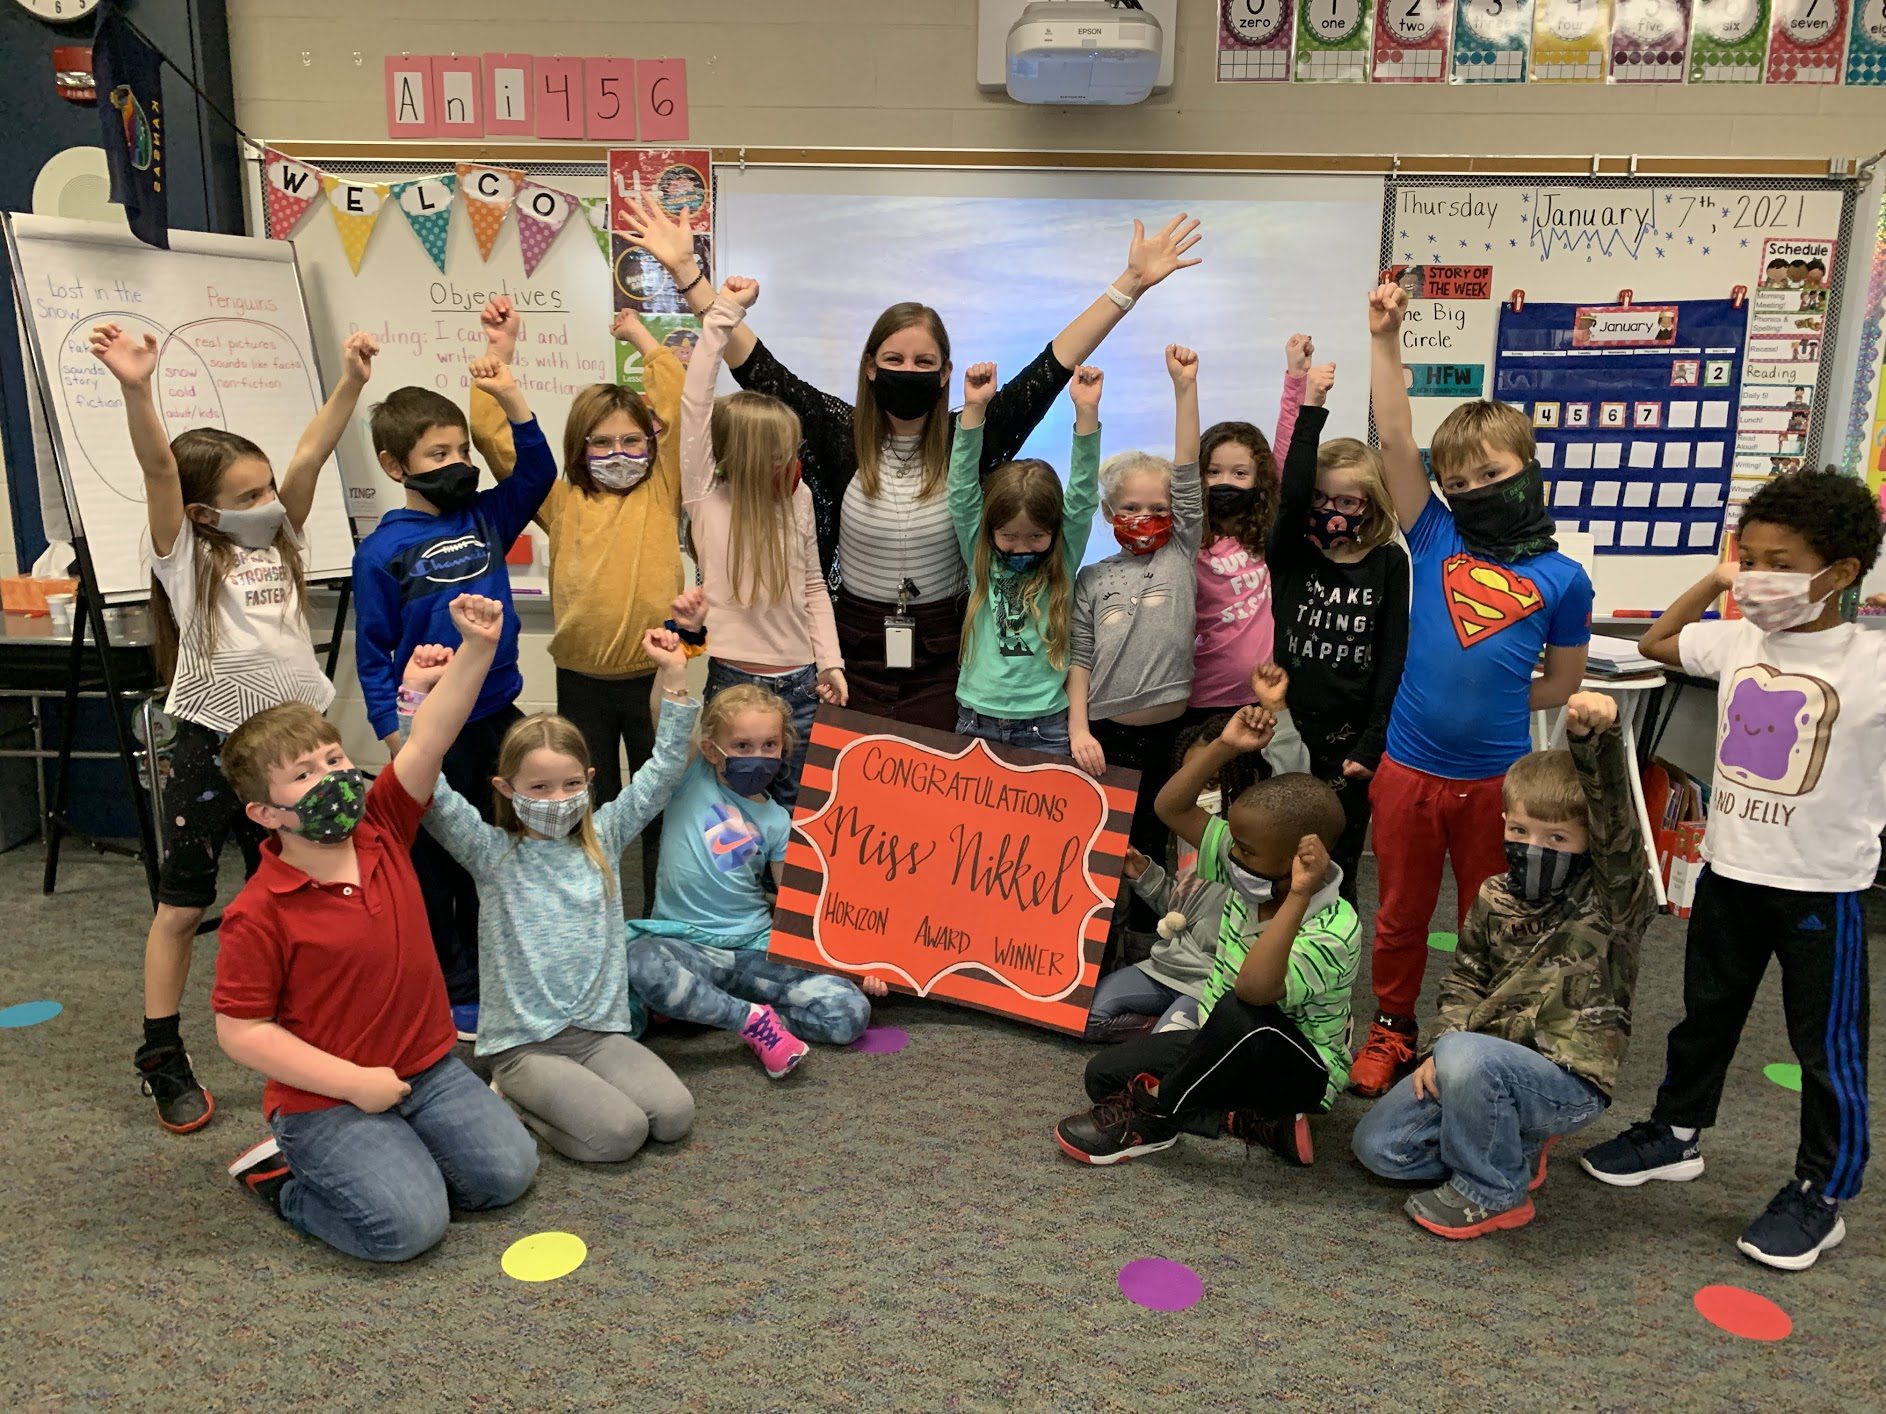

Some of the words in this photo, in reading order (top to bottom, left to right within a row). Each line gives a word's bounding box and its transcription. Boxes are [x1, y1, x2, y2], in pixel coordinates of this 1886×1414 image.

[54, 0, 62, 14] 6
[1239, 18, 1271, 28] zero
[1321, 19, 1346, 29] one
[1399, 18, 1425, 32] two
[1557, 17, 1586, 31] four
[1637, 20, 1665, 32] five
[1722, 20, 1741, 32] six
[1790, 17, 1829, 30] seven
[66, 90, 89, 98] FIRE
[1401, 190, 1498, 229] Thursday
[1537, 193, 1650, 243] January
[1733, 194, 1805, 229] 2021
[1769, 243, 1828, 256] Schedule
[1429, 267, 1471, 280] STORY
[1473, 267, 1489, 280] OF
[48, 274, 84, 300] Lost
[94, 287, 109, 301] in
[115, 280, 144, 304] the
[430, 279, 562, 310] Objectives
[1429, 282, 1450, 297] THE
[1454, 282, 1488, 297] WEEK
[1757, 292, 1785, 300] Morning
[207, 286, 279, 315] Penguins
[37, 299, 80, 321] Snow
[1434, 302, 1466, 331] Big
[435, 320, 449, 340] I
[538, 323, 568, 346] and
[1599, 320, 1654, 334] January
[195, 337, 221, 349] real
[228, 338, 277, 355] pictures
[1403, 330, 1452, 348] Circle
[210, 358, 248, 369] sounds
[251, 359, 269, 369] like
[272, 356, 301, 370] facts
[536, 351, 569, 370] with
[576, 351, 606, 381] long
[165, 367, 197, 378] snow
[1426, 366, 1472, 385] HFW
[1713, 366, 1724, 380] 2
[1746, 365, 1797, 383] Reading
[64, 374, 98, 390] story
[217, 377, 282, 389] non-fiction
[169, 385, 196, 397] cold
[1743, 392, 1760, 400] Daily
[76, 394, 123, 408] fiction
[1541, 409, 1551, 422] 4
[1573, 409, 1582, 422] 5
[1608, 409, 1618, 422] 6
[1643, 409, 1653, 422] 7
[1740, 416, 1763, 424] Lunch!
[1735, 461, 1761, 470] Writing!
[245, 588, 286, 606] FASTER
[1313, 579, 1374, 606] MAKE
[1288, 635, 1373, 663] HAPPEN
[863, 747, 1068, 823] CONGRATULATIONS
[1739, 798, 1796, 827] JELLY
[824, 805, 936, 881] Miss
[949, 823, 1082, 915] Nikkel
[824, 892, 890, 935] HORIZON
[914, 915, 971, 954] AWARD
[994, 936, 1065, 977] WINNER
